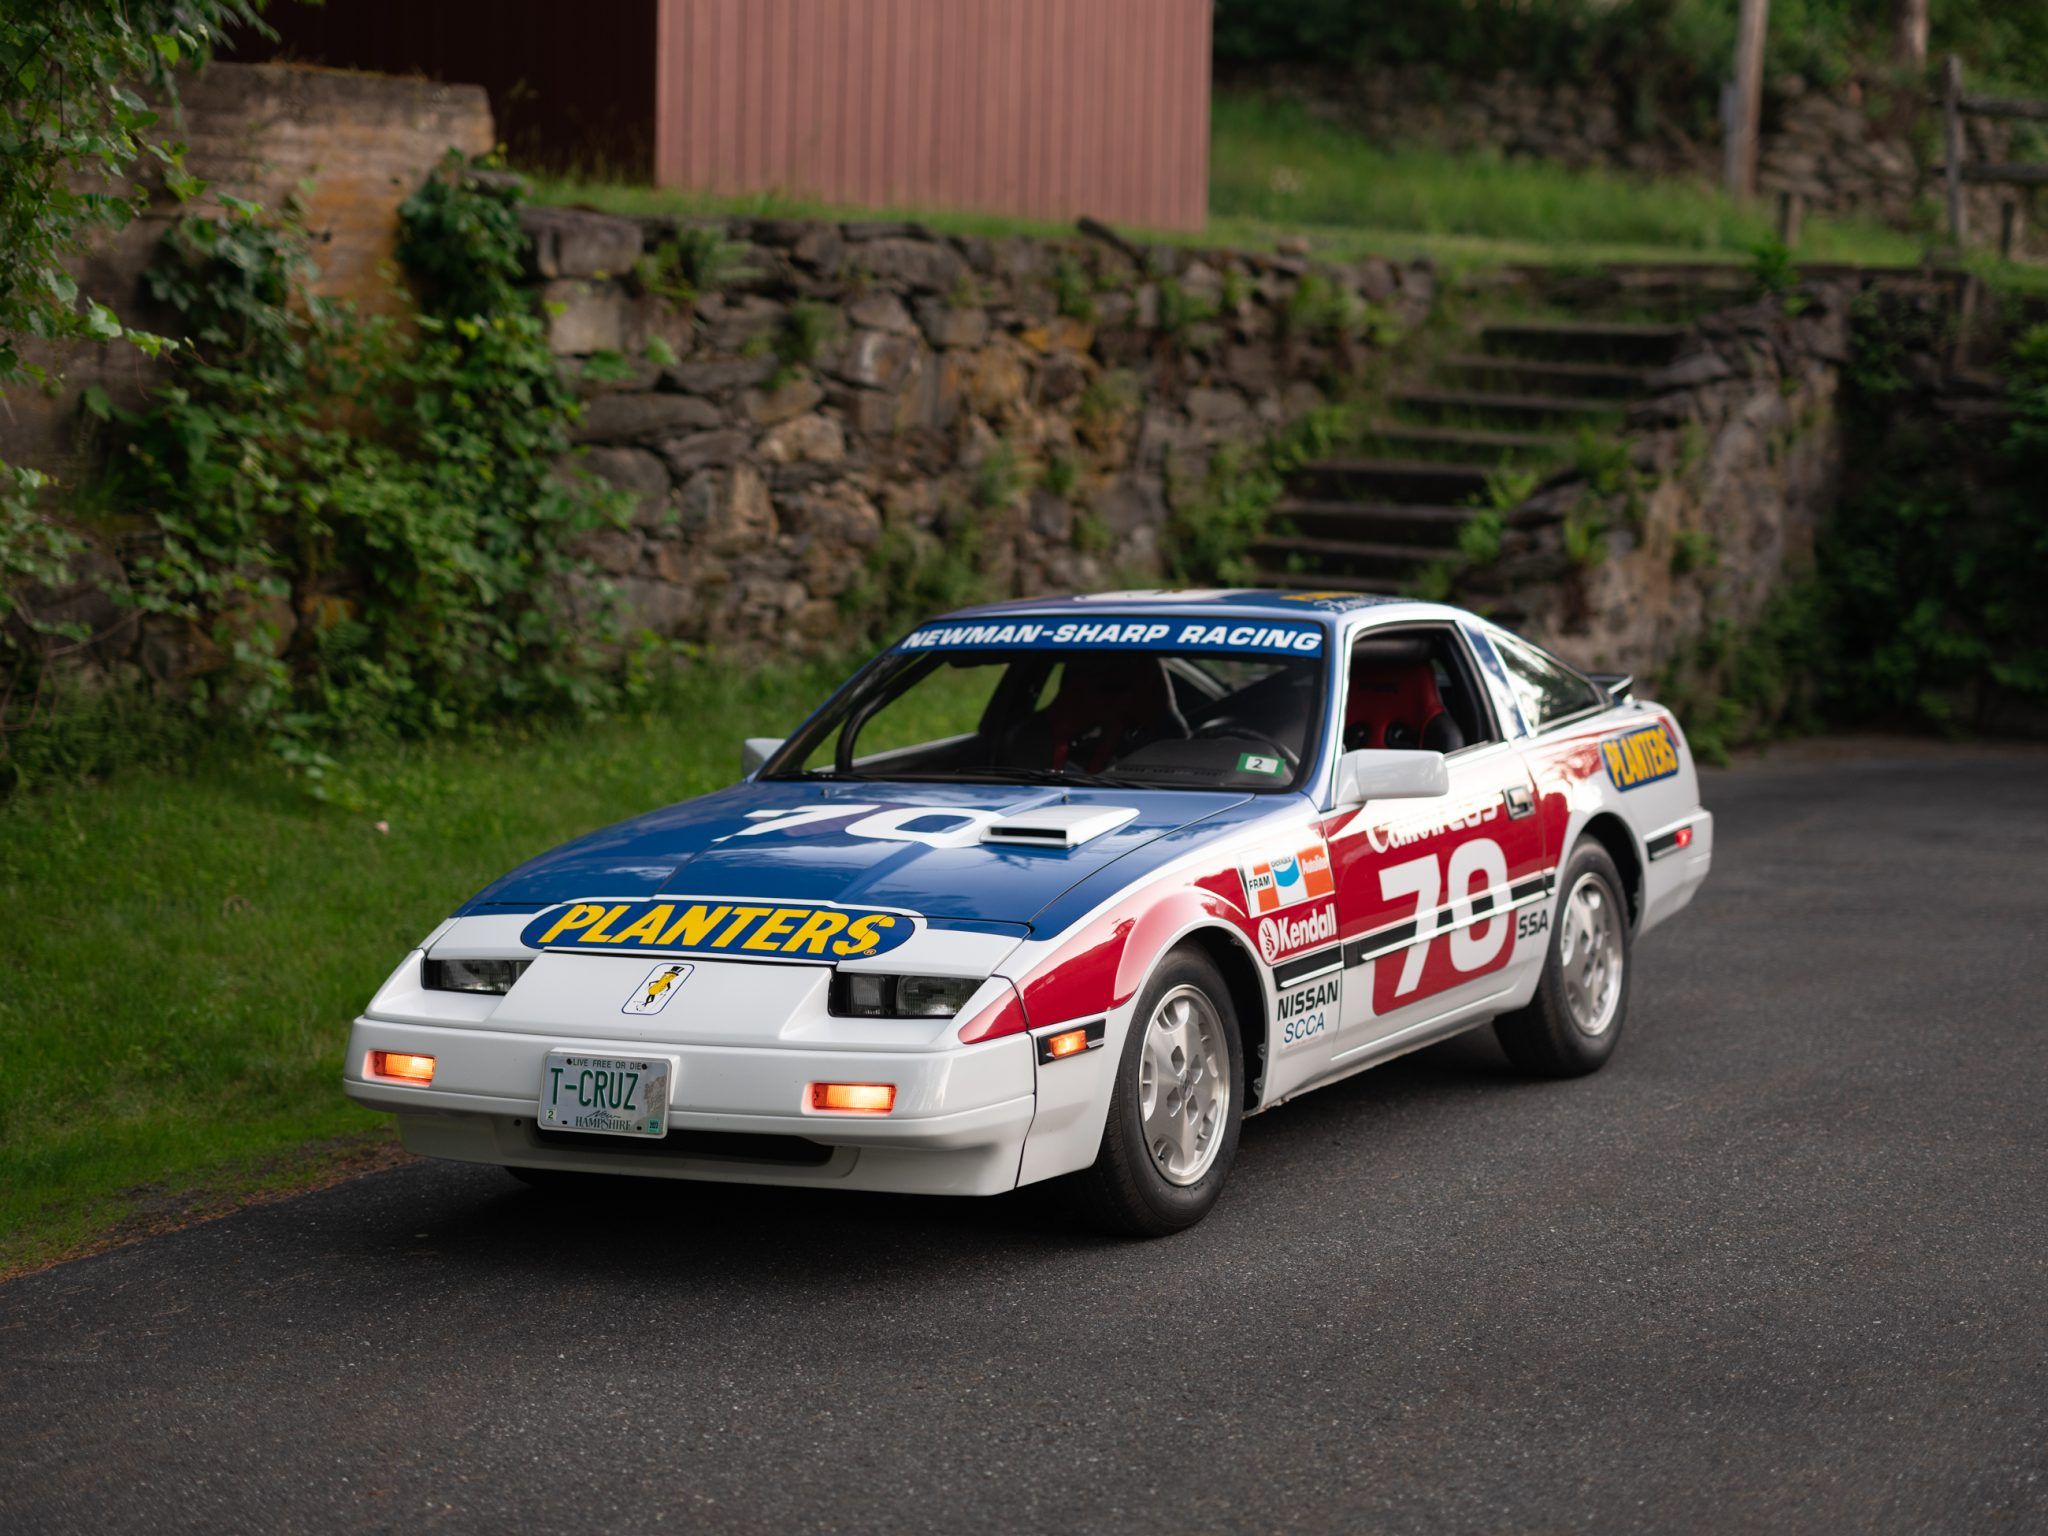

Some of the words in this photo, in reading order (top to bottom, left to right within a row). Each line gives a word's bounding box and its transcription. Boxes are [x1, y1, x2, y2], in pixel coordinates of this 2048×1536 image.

[901, 624, 1170, 650] NEWMAN-SHARP
[1176, 624, 1323, 651] RACING
[1252, 758, 1263, 770] 2
[1602, 726, 1678, 788] PLANTERS
[711, 804, 1004, 849] 70
[1248, 875, 1271, 891] FRAM
[537, 903, 899, 955] PLANTERS
[1277, 902, 1337, 952] Kendall
[1378, 837, 1510, 998] 70
[1518, 909, 1549, 940] SSA
[1277, 979, 1339, 1022] NISSAN
[1283, 1011, 1325, 1044] SCCA
[572, 1058, 589, 1068] LIVE
[592, 1059, 612, 1069] FREE
[615, 1061, 626, 1070] OR
[629, 1062, 643, 1071] DIE
[550, 1067, 639, 1111] T-CRUZ
[547, 1109, 555, 1120] 2
[575, 1115, 632, 1131] HAMPSHIRE
